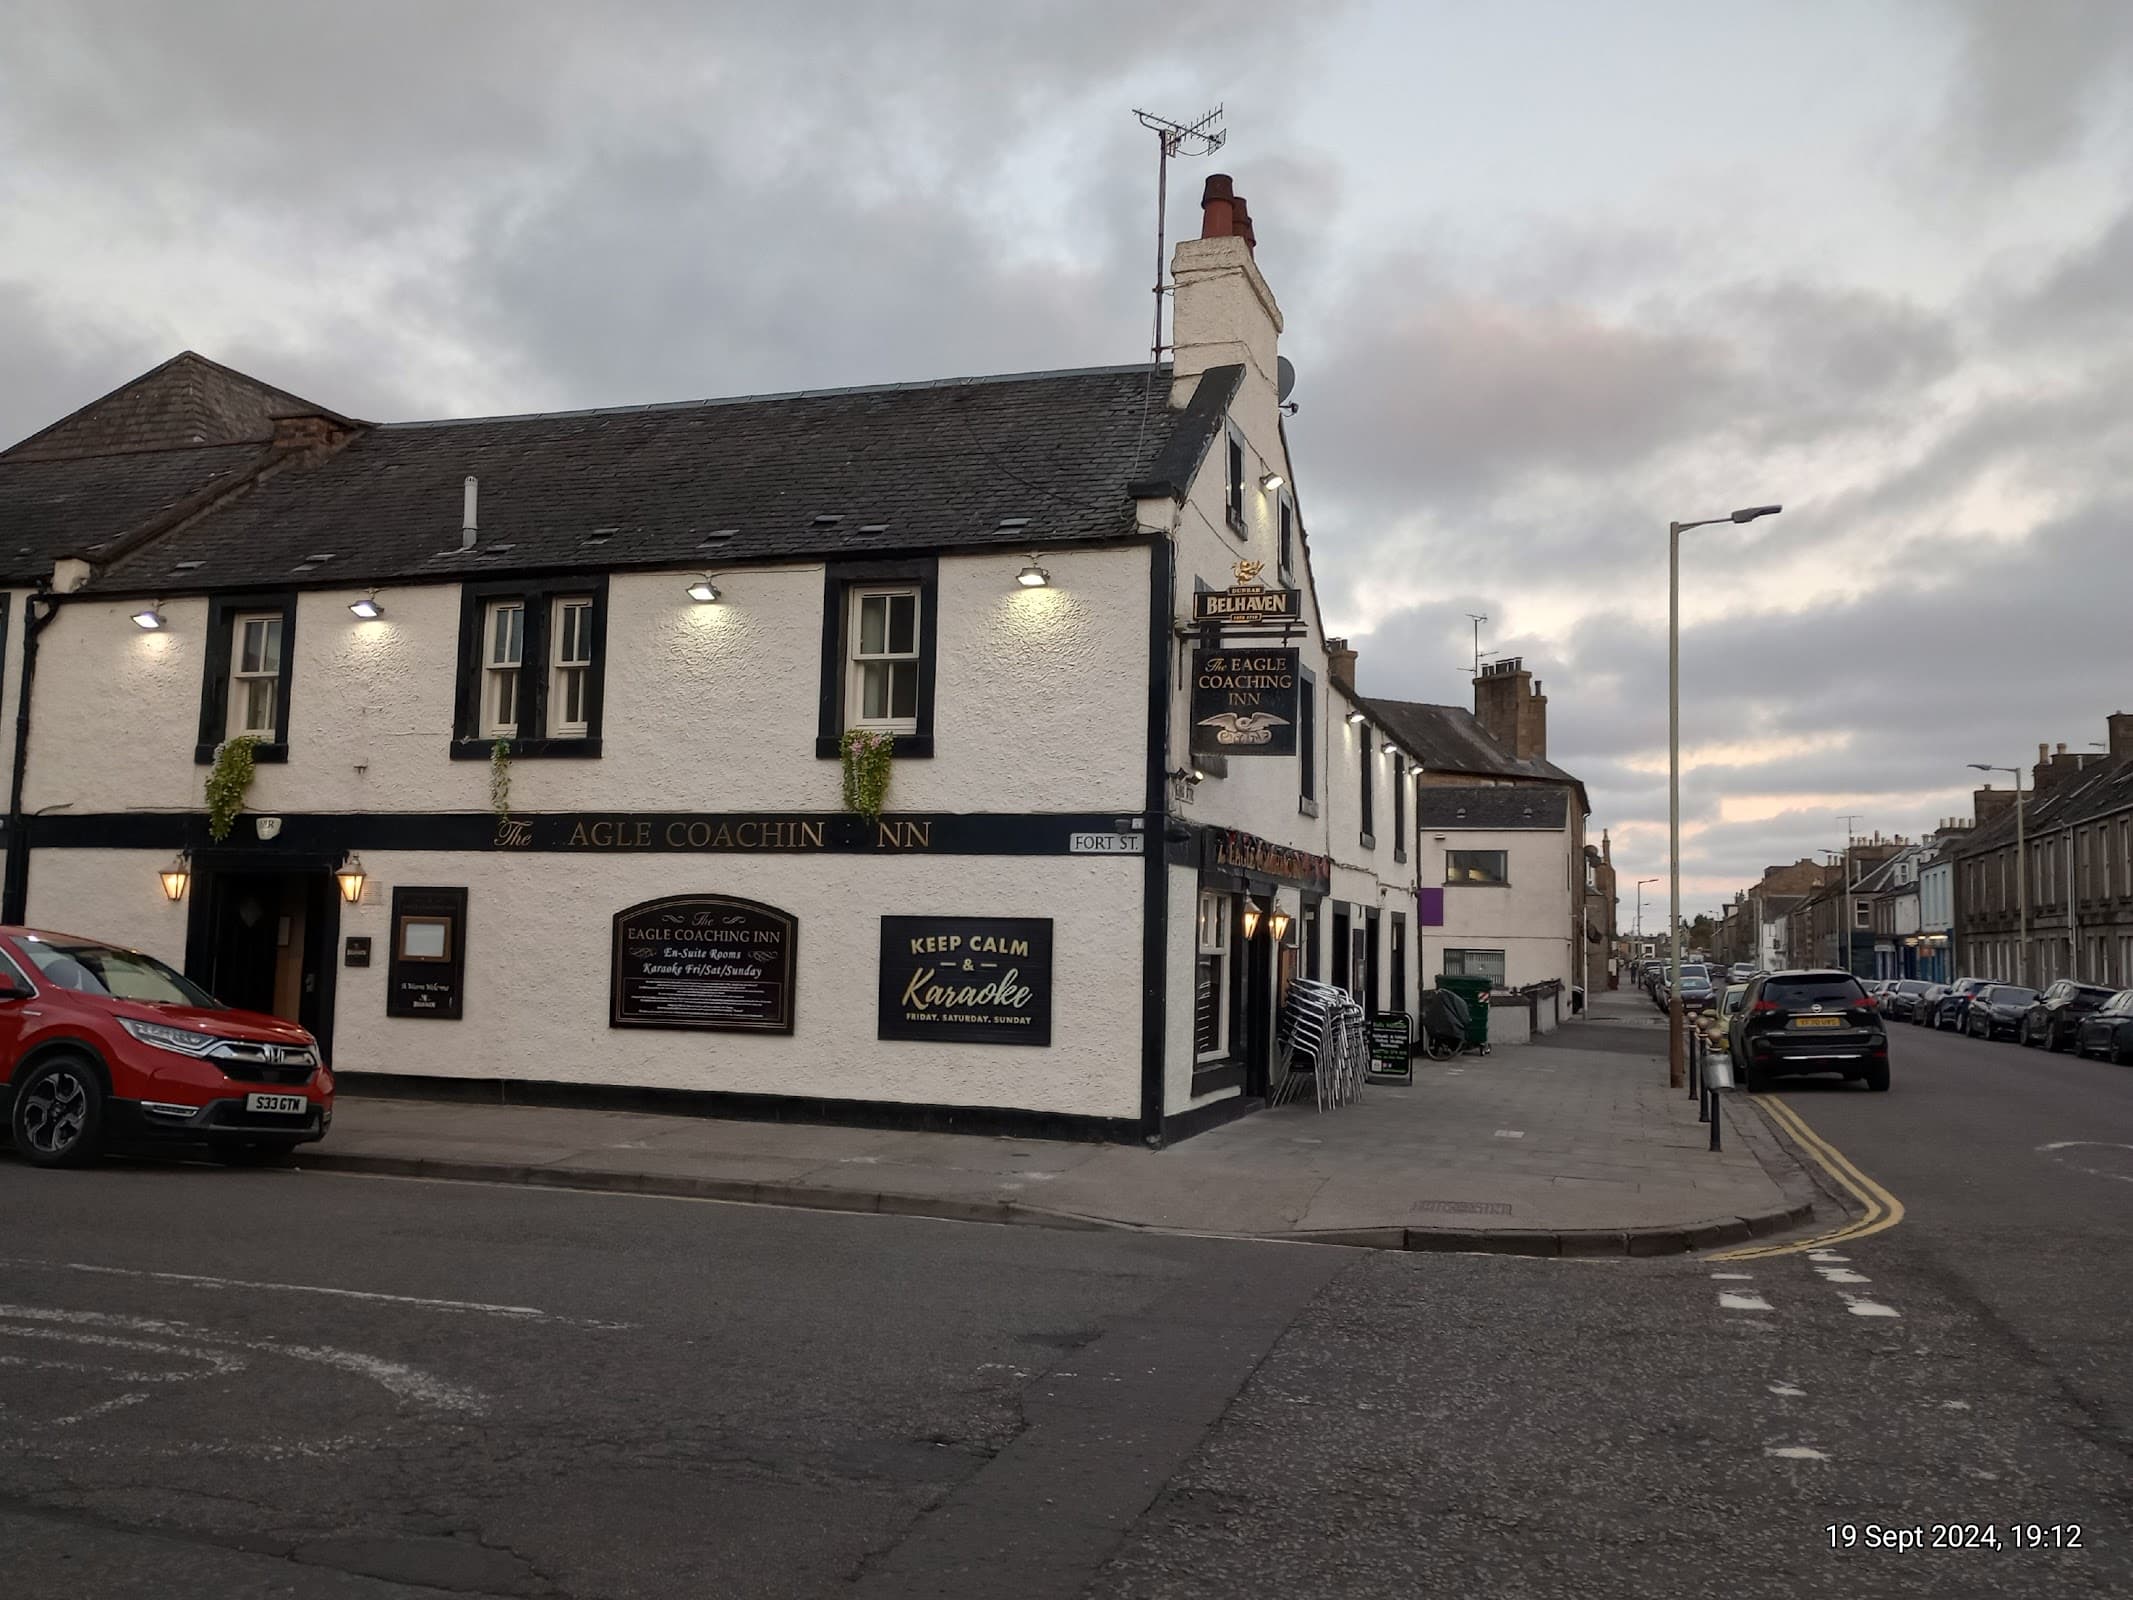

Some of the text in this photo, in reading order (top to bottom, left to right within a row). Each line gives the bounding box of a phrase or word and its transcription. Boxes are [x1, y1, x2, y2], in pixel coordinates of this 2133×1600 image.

[1207, 594, 1286, 615] BELHAVEN
[1205, 658, 1287, 672] The EAGLE
[1198, 674, 1292, 689] COACHING
[1229, 692, 1260, 705] INN
[494, 820, 533, 846] The
[1075, 836, 1138, 850] FORT ST.
[691, 911, 715, 927] The
[628, 928, 781, 944] EAGLE COACHING INN
[663, 947, 742, 961] En-Suite Rooms
[911, 936, 1028, 957] KEEP CALM
[642, 962, 762, 980] Karaoke Fri/Sat/Sunday
[962, 958, 974, 972] &
[902, 967, 1033, 1010] Karaoke
[994, 1016, 1032, 1025] SUNDAY
[256, 1096, 278, 1110] S33
